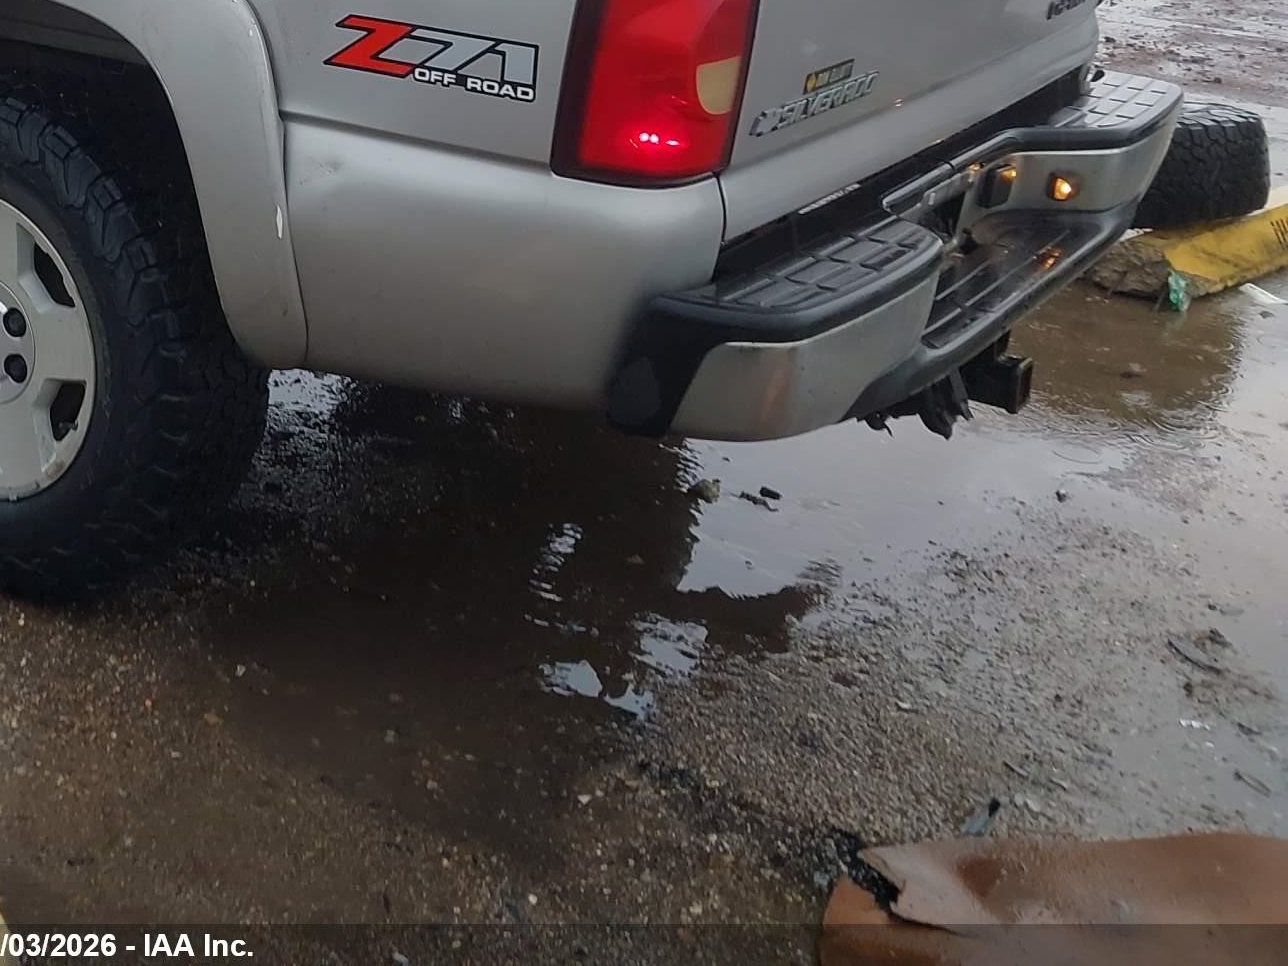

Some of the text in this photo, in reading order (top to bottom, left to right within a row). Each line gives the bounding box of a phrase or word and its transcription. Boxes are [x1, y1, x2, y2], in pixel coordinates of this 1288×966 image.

[323, 13, 540, 84] Z71
[414, 68, 535, 101] OFF ROAD
